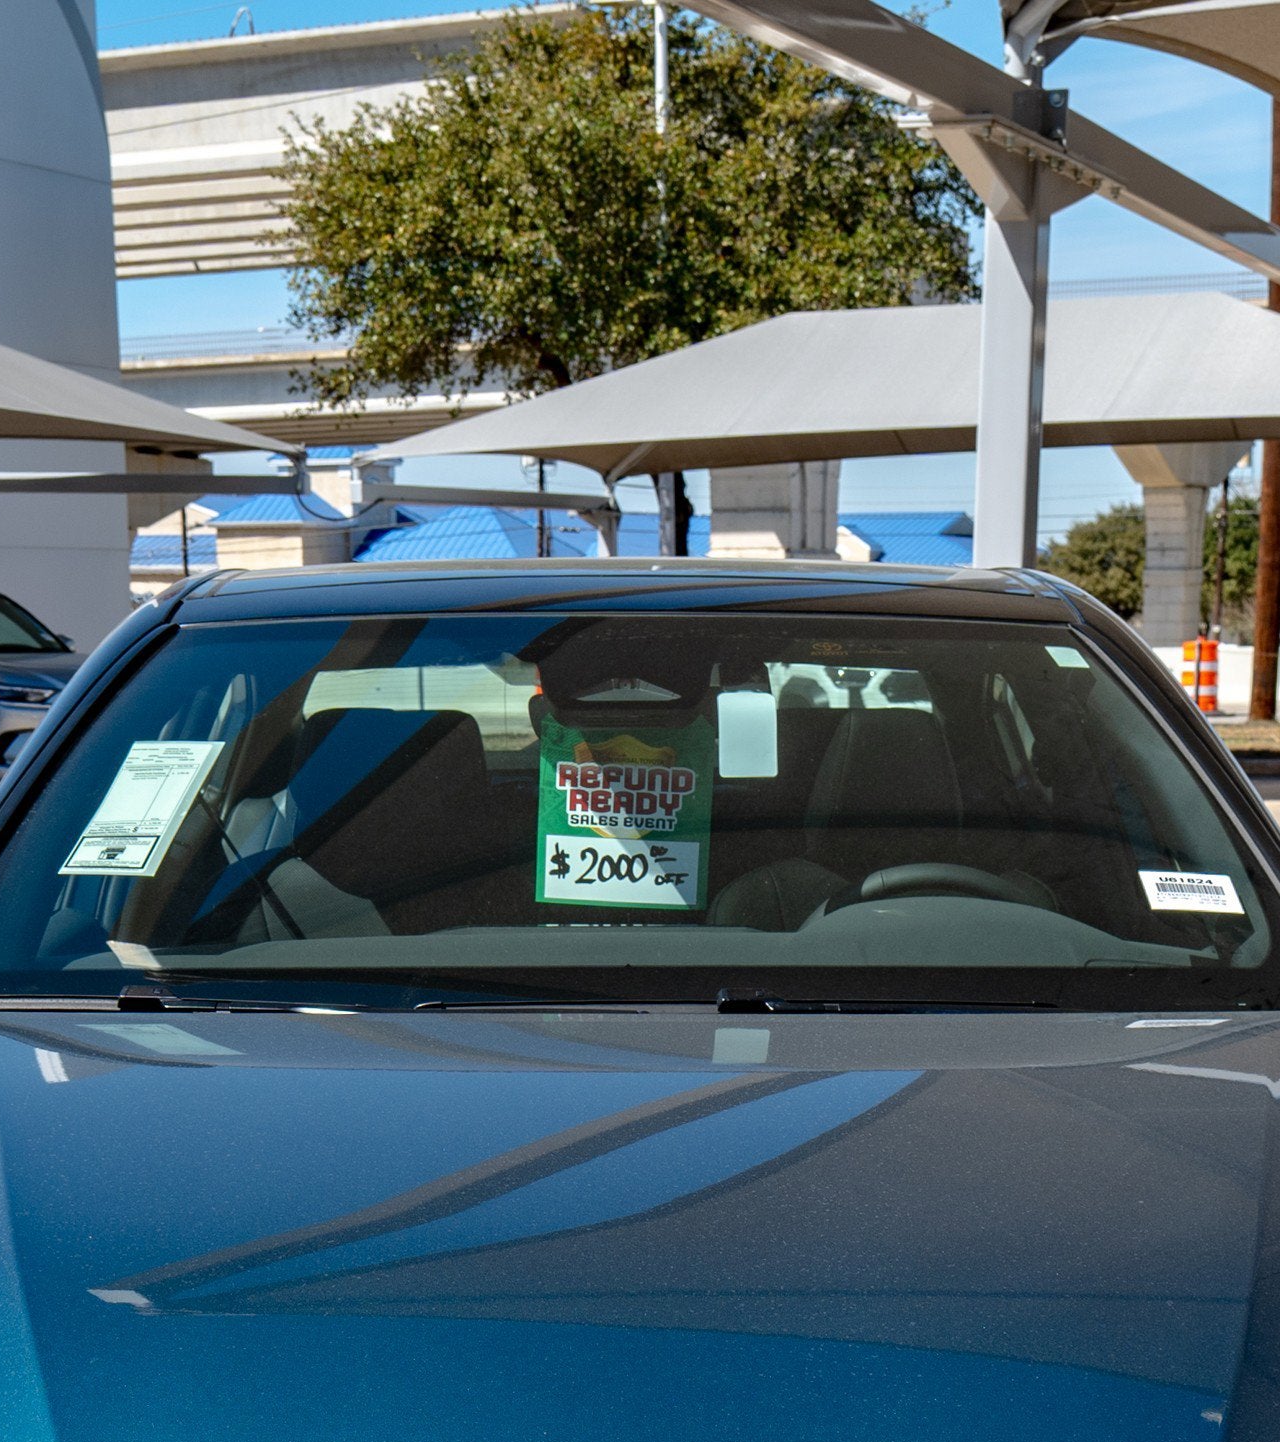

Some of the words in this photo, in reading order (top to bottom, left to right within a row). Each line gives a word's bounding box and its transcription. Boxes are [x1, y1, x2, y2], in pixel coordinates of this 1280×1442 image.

[558, 764, 694, 793] REFUND
[569, 789, 681, 817] READY
[570, 814, 619, 827] SALES
[623, 817, 676, 830] EVENT
